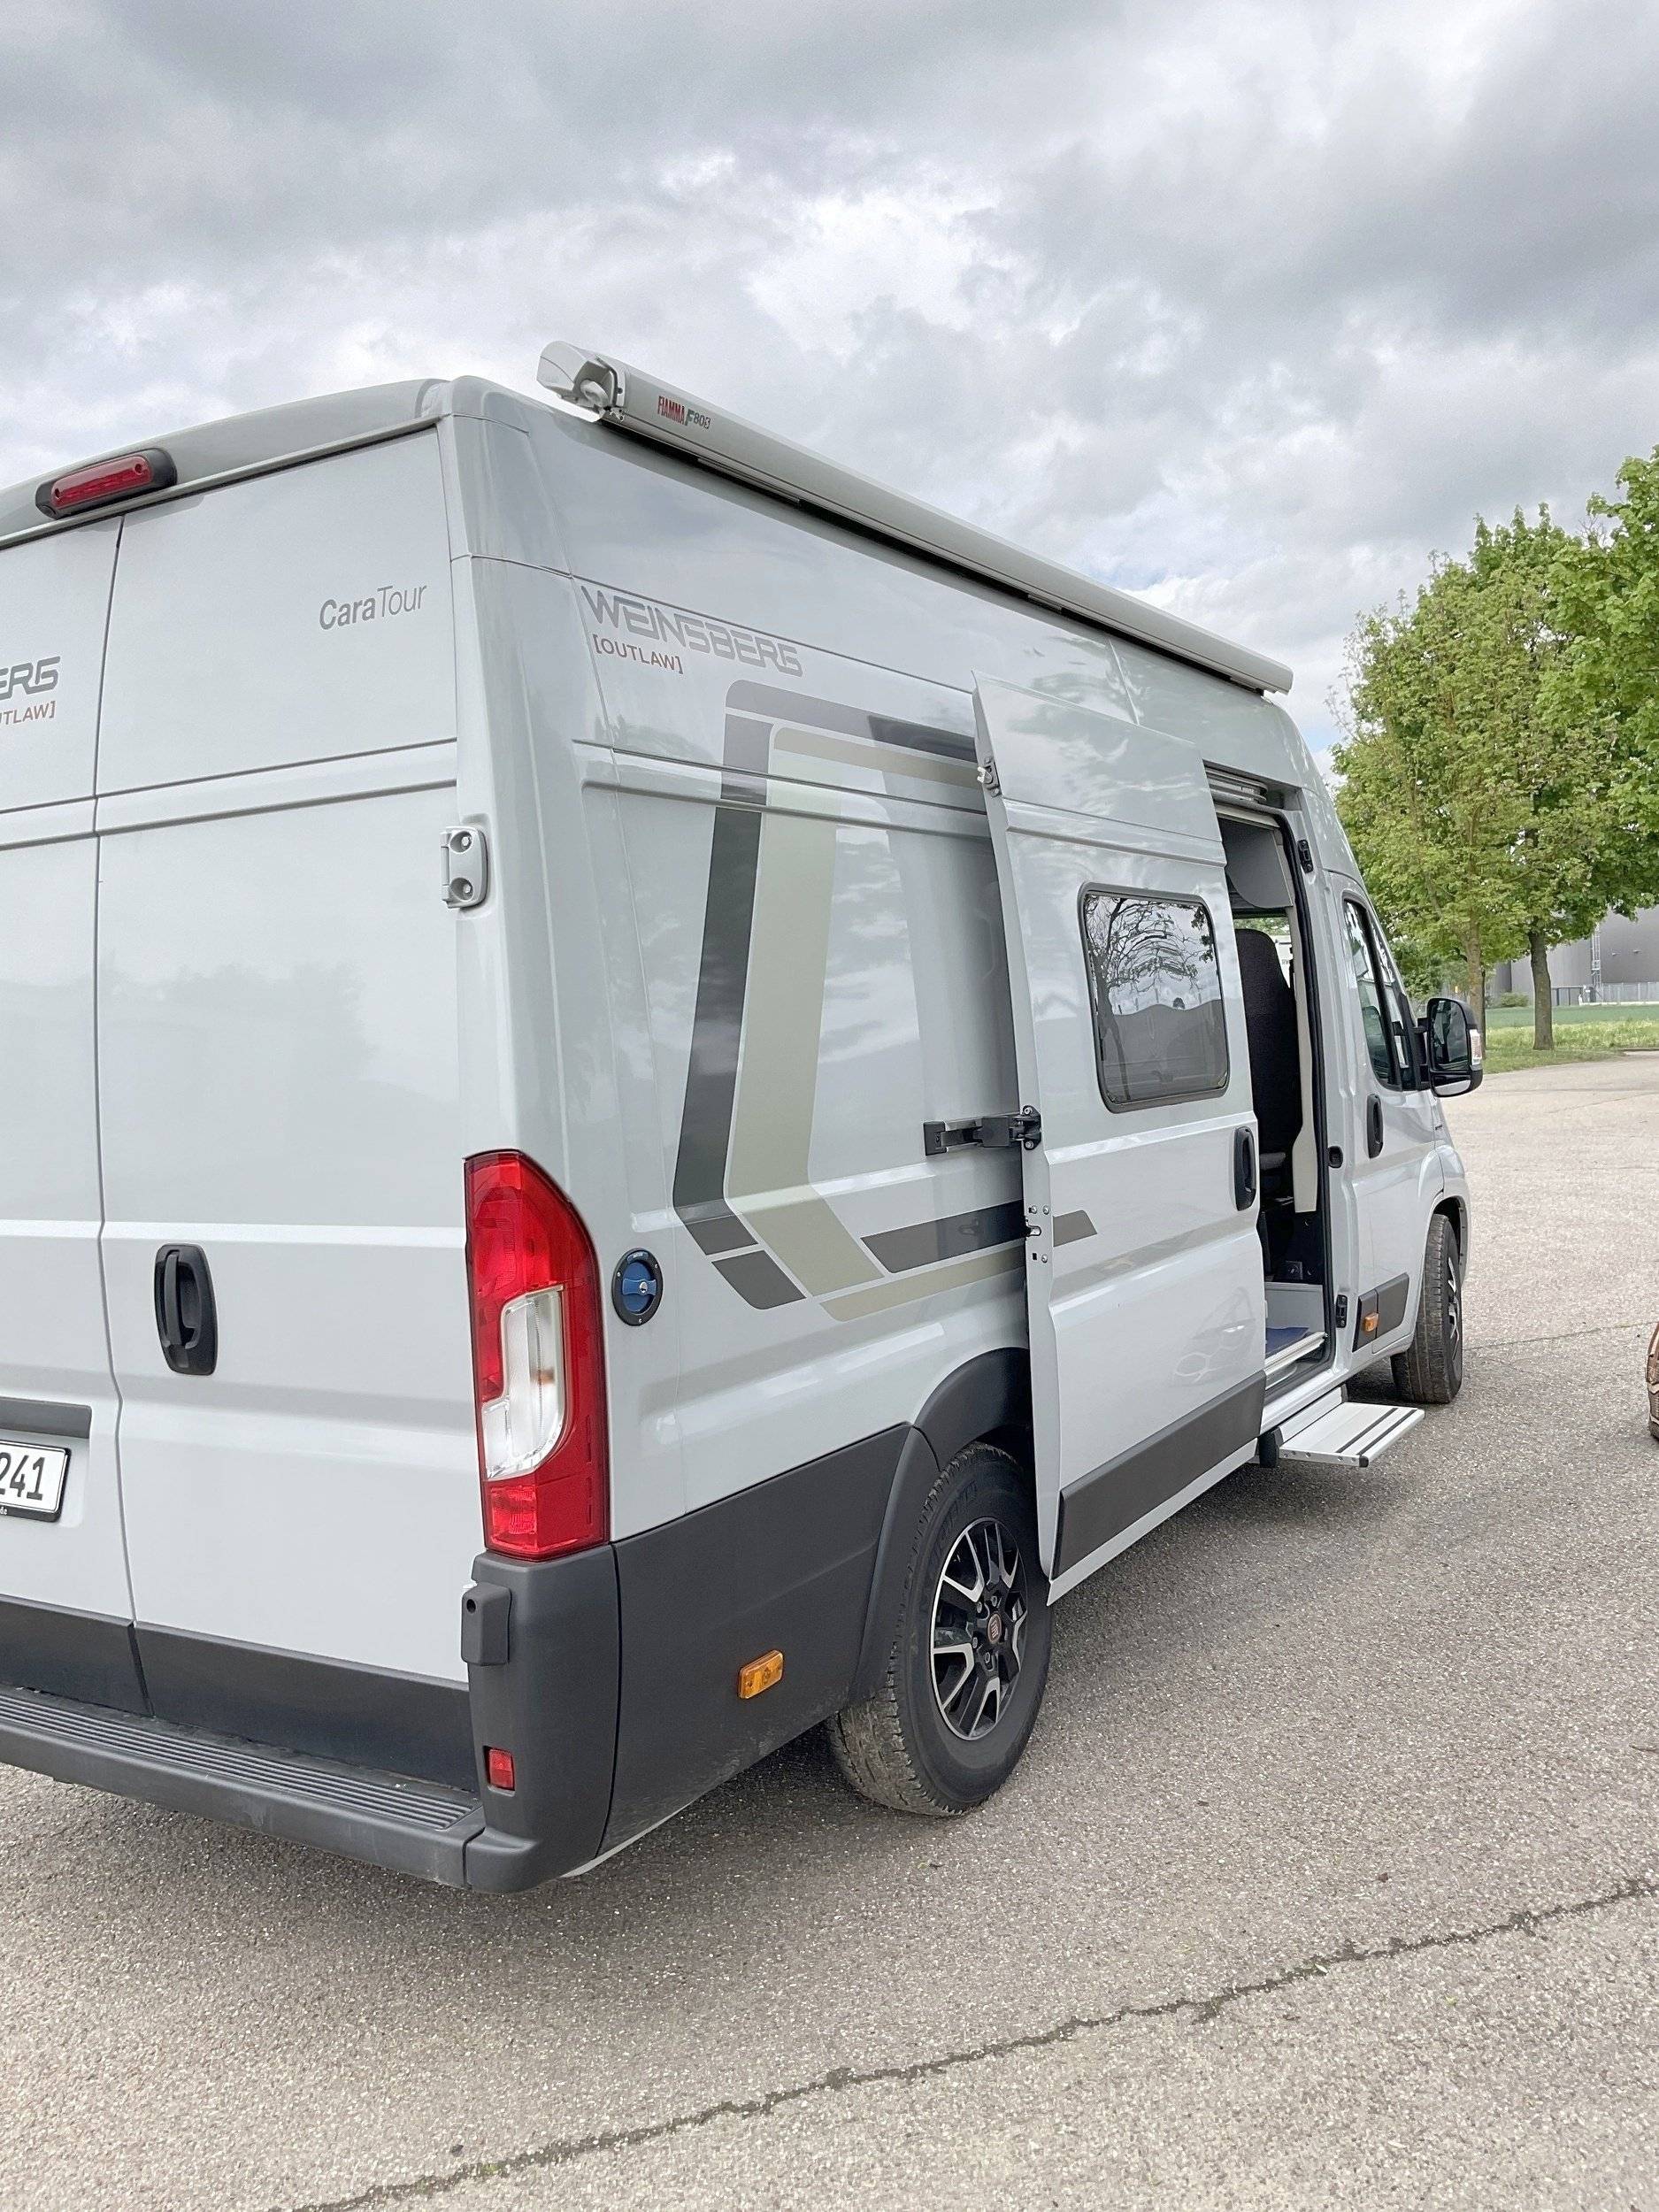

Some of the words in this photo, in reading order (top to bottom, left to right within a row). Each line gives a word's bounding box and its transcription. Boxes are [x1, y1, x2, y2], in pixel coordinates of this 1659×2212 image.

[657, 396, 685, 426] FIAMMA
[319, 585, 427, 630] CaraTour
[580, 585, 803, 678] WEINSBERG
[592, 634, 684, 675] [OUTLAW]
[0, 700, 56, 725] TLAW]
